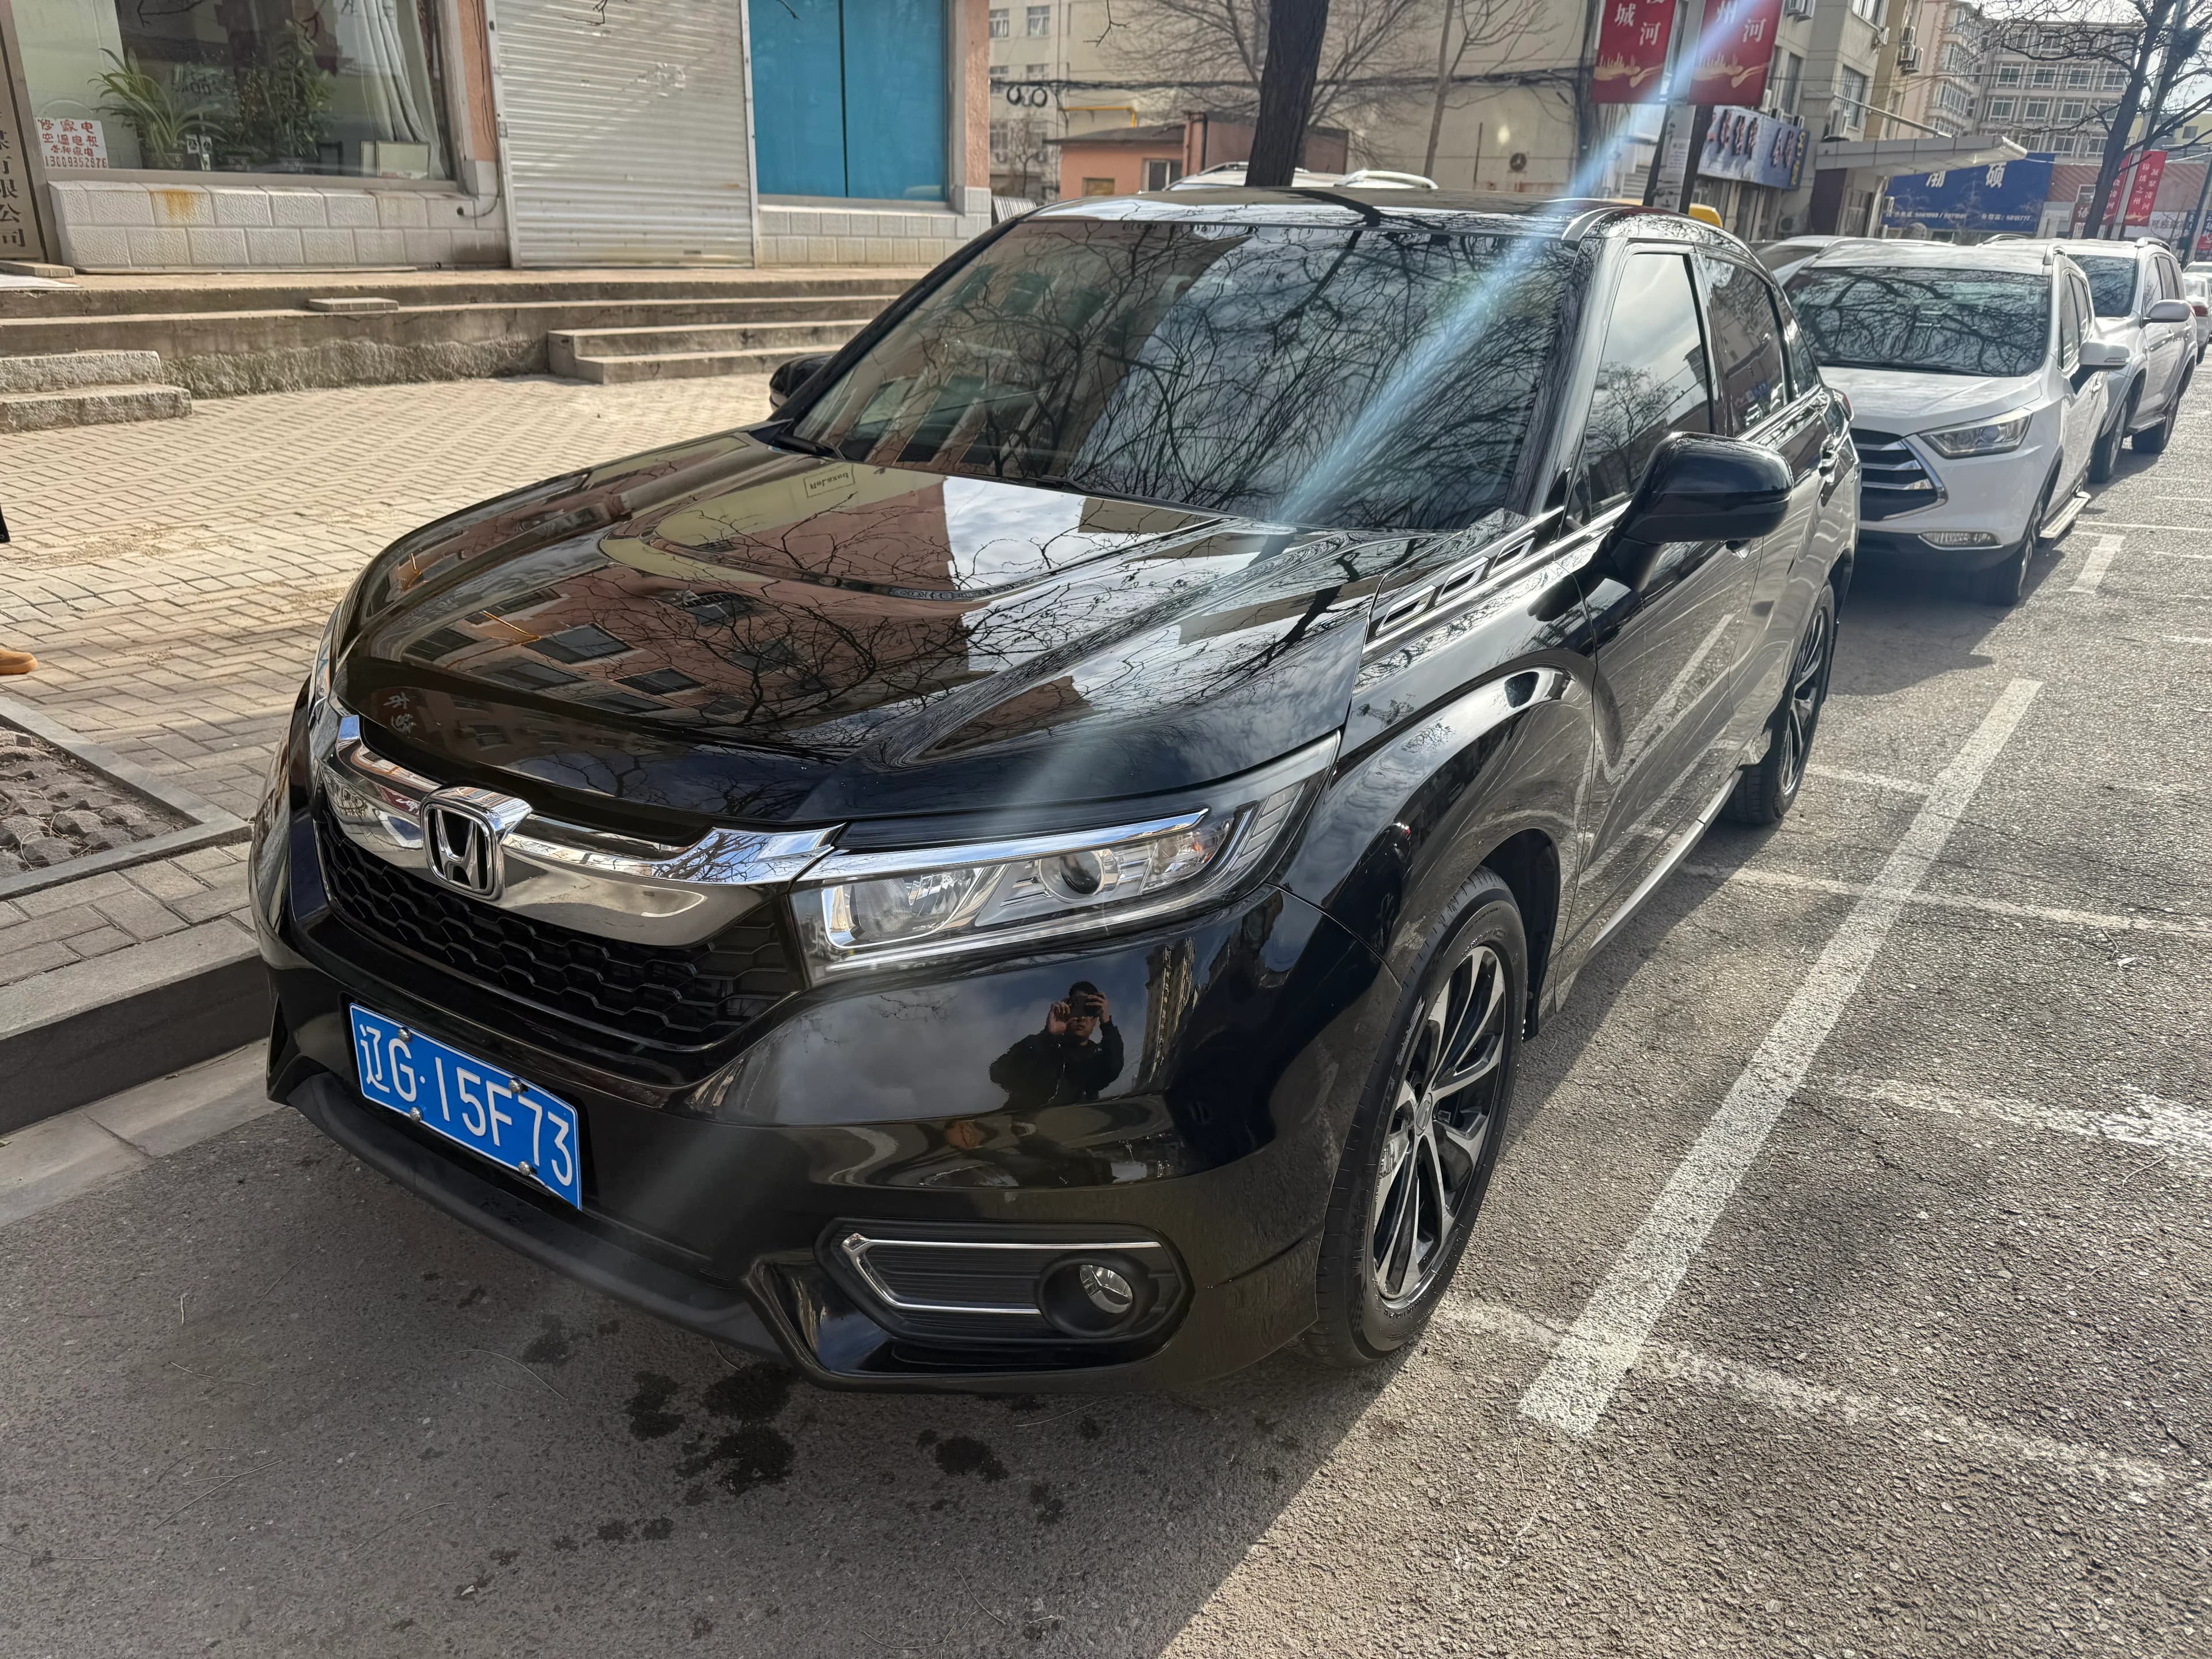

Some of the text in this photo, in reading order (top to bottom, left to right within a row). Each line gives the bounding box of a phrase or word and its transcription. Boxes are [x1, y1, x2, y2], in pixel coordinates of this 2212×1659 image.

[1614, 3, 1637, 27] 城
[1715, 0, 1738, 24] 州
[1742, 18, 1767, 43] 河
